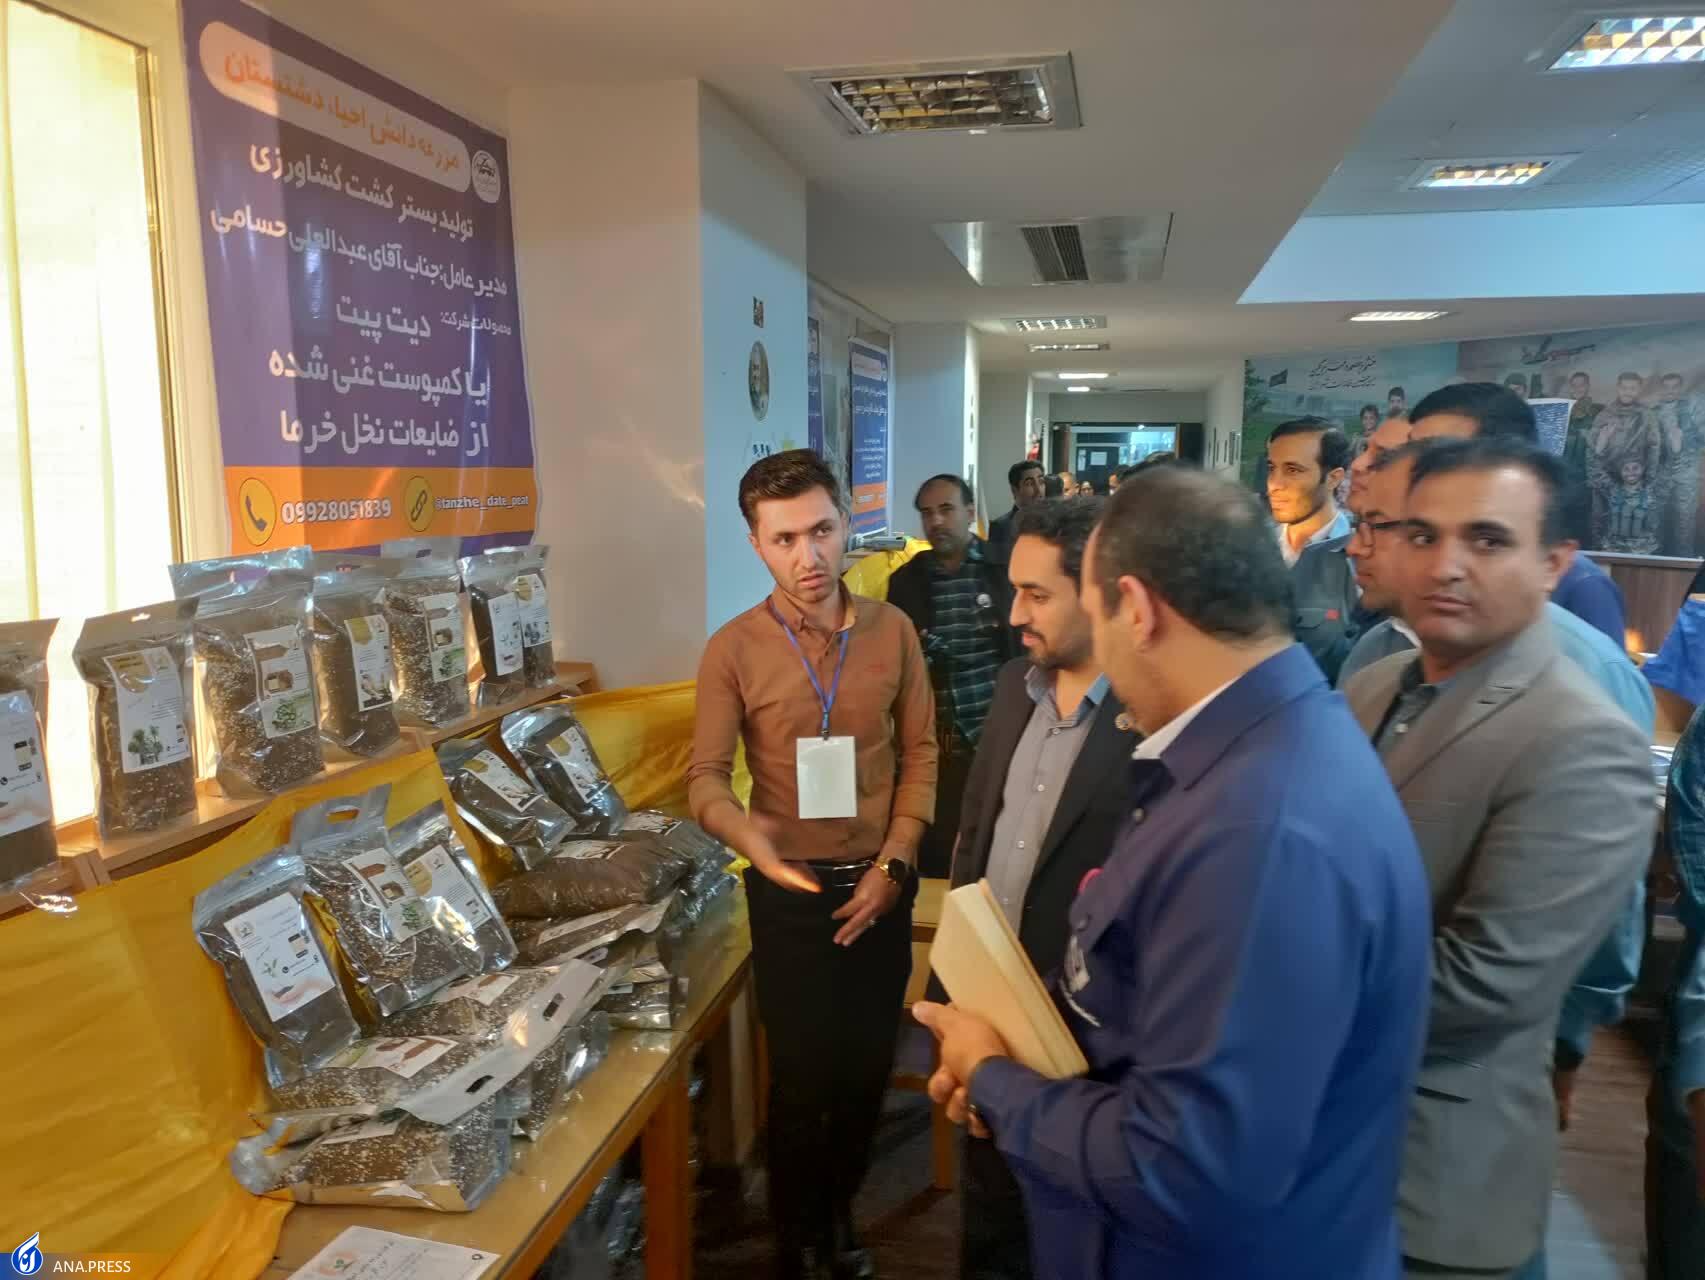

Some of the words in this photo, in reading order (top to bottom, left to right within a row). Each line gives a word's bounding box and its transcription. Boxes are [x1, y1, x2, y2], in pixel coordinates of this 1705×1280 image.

[250, 143, 343, 189] کشاورزی
[344, 177, 394, 209] کشت
[210, 204, 288, 238] حسامی
[398, 195, 437, 232] بستر
[440, 210, 473, 242] تولید
[368, 242, 402, 271] آقای
[403, 255, 440, 285] جناب
[474, 277, 508, 297] مدیر
[335, 296, 382, 344] پیت
[386, 306, 432, 345] دیت
[269, 344, 328, 381] شده
[332, 355, 375, 394] غنی
[378, 361, 462, 407] کمپوست
[280, 409, 337, 454] خرما
[341, 413, 385, 454] نخل
[388, 418, 459, 456] ضایعات
[465, 421, 489, 457] از
[281, 499, 392, 524] 09928051839
